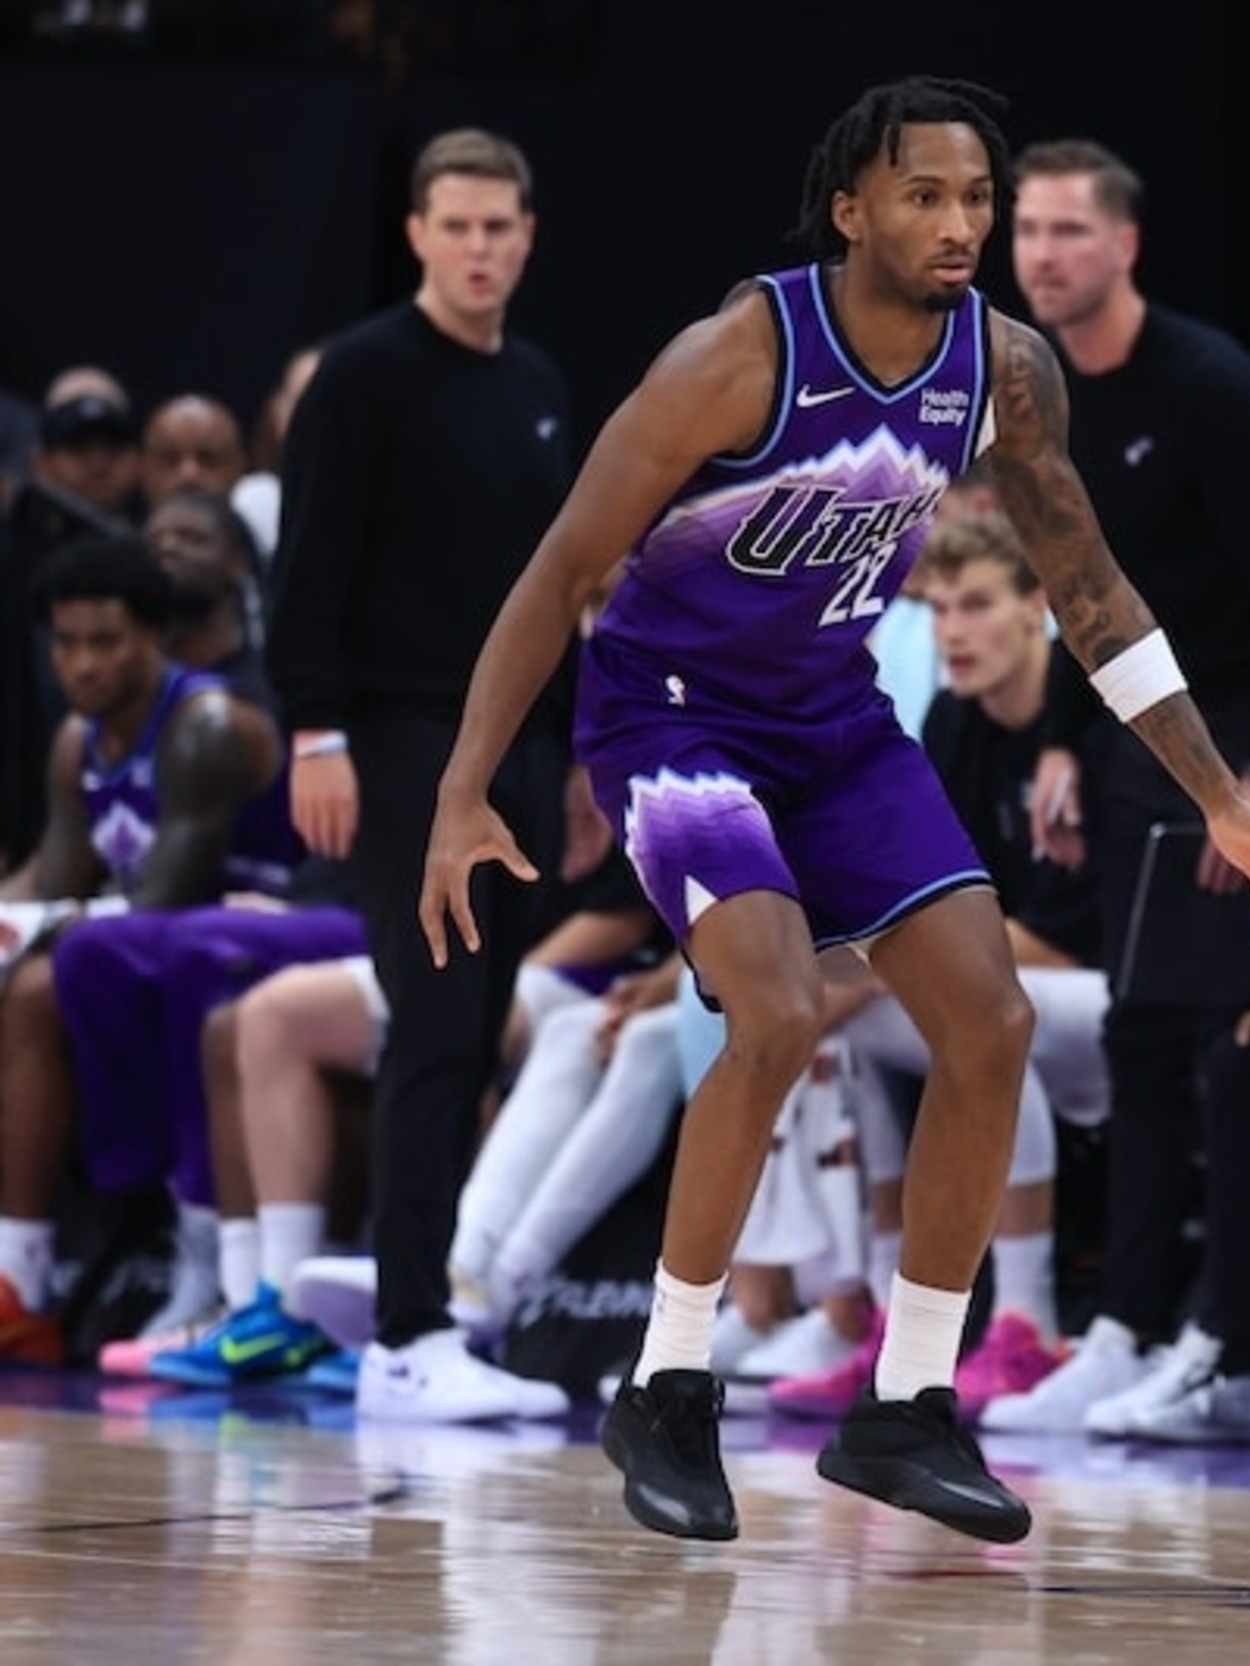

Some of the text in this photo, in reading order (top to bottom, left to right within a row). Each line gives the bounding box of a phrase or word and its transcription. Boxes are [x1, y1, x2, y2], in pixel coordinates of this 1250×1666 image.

[918, 406, 966, 427] Equity
[921, 389, 969, 407] Health
[725, 483, 948, 577] UTAH
[818, 541, 897, 627] 22
